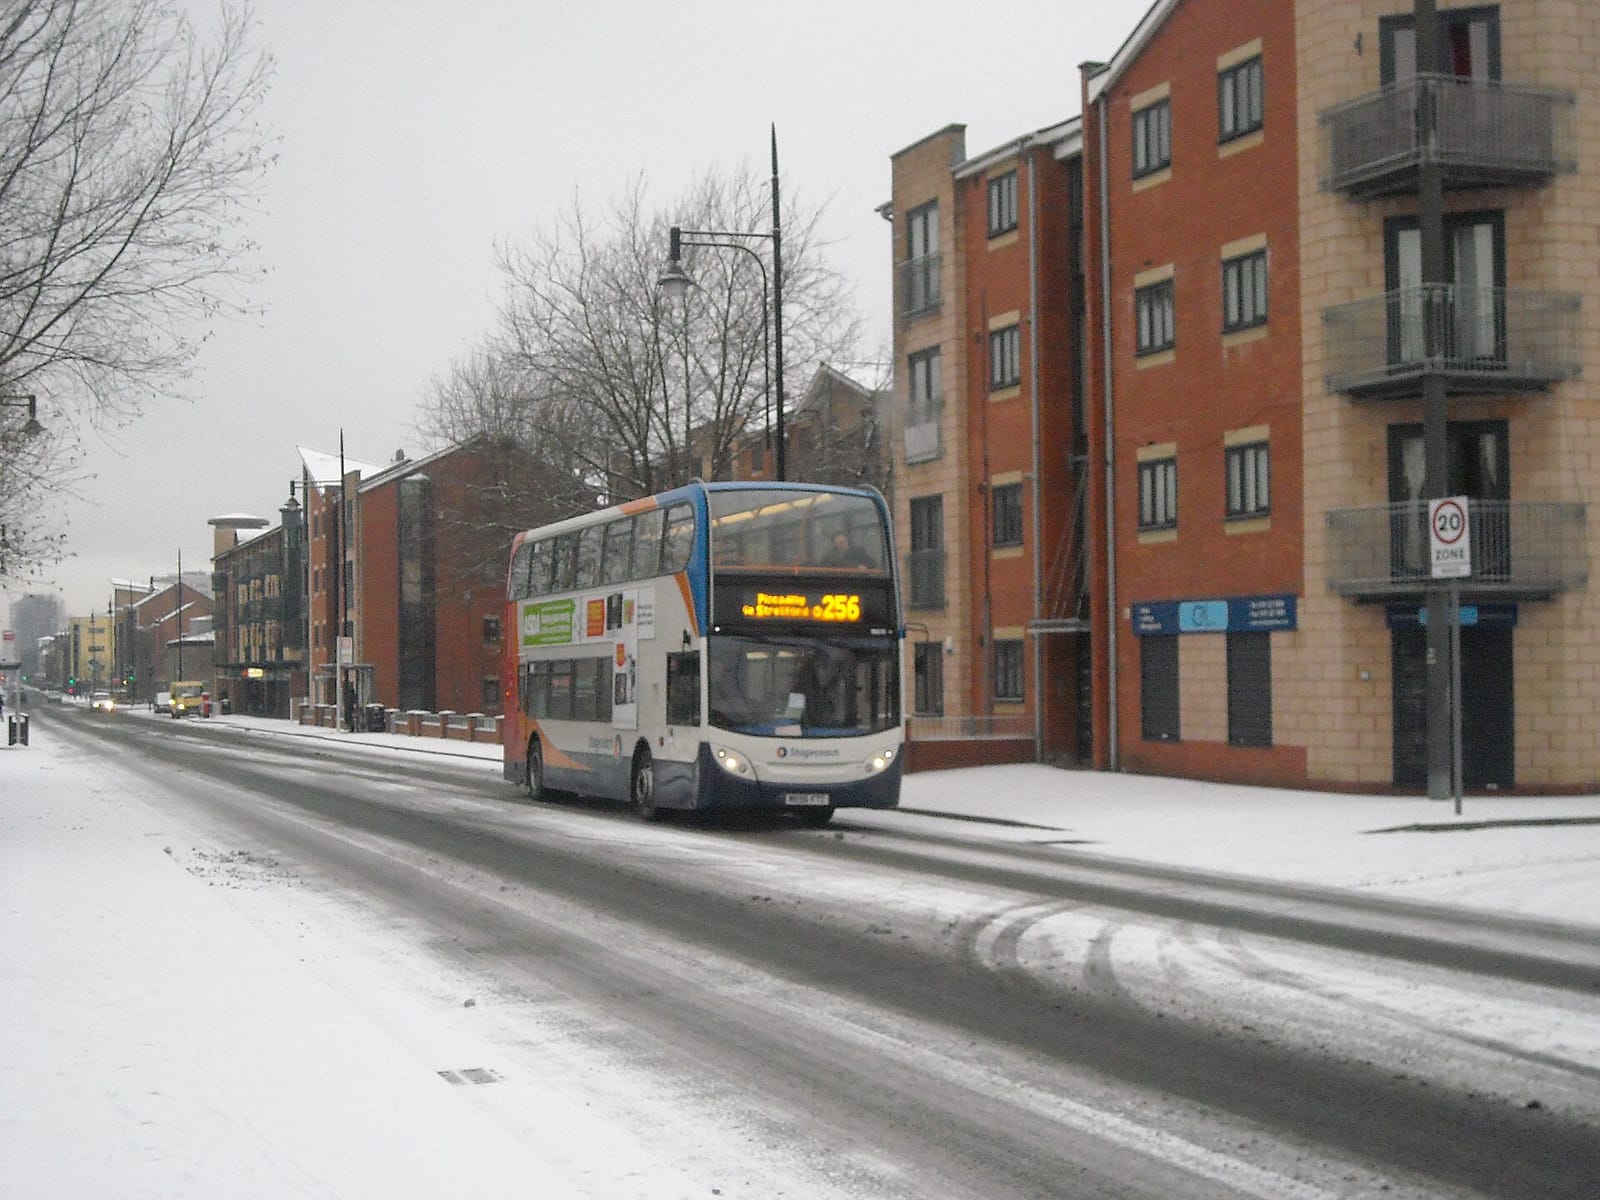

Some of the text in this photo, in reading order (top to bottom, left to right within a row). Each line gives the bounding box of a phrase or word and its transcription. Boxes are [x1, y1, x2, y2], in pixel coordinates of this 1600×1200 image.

[1438, 513, 1460, 531] 20
[1437, 548, 1465, 560] ZONE
[823, 595, 860, 620] 256
